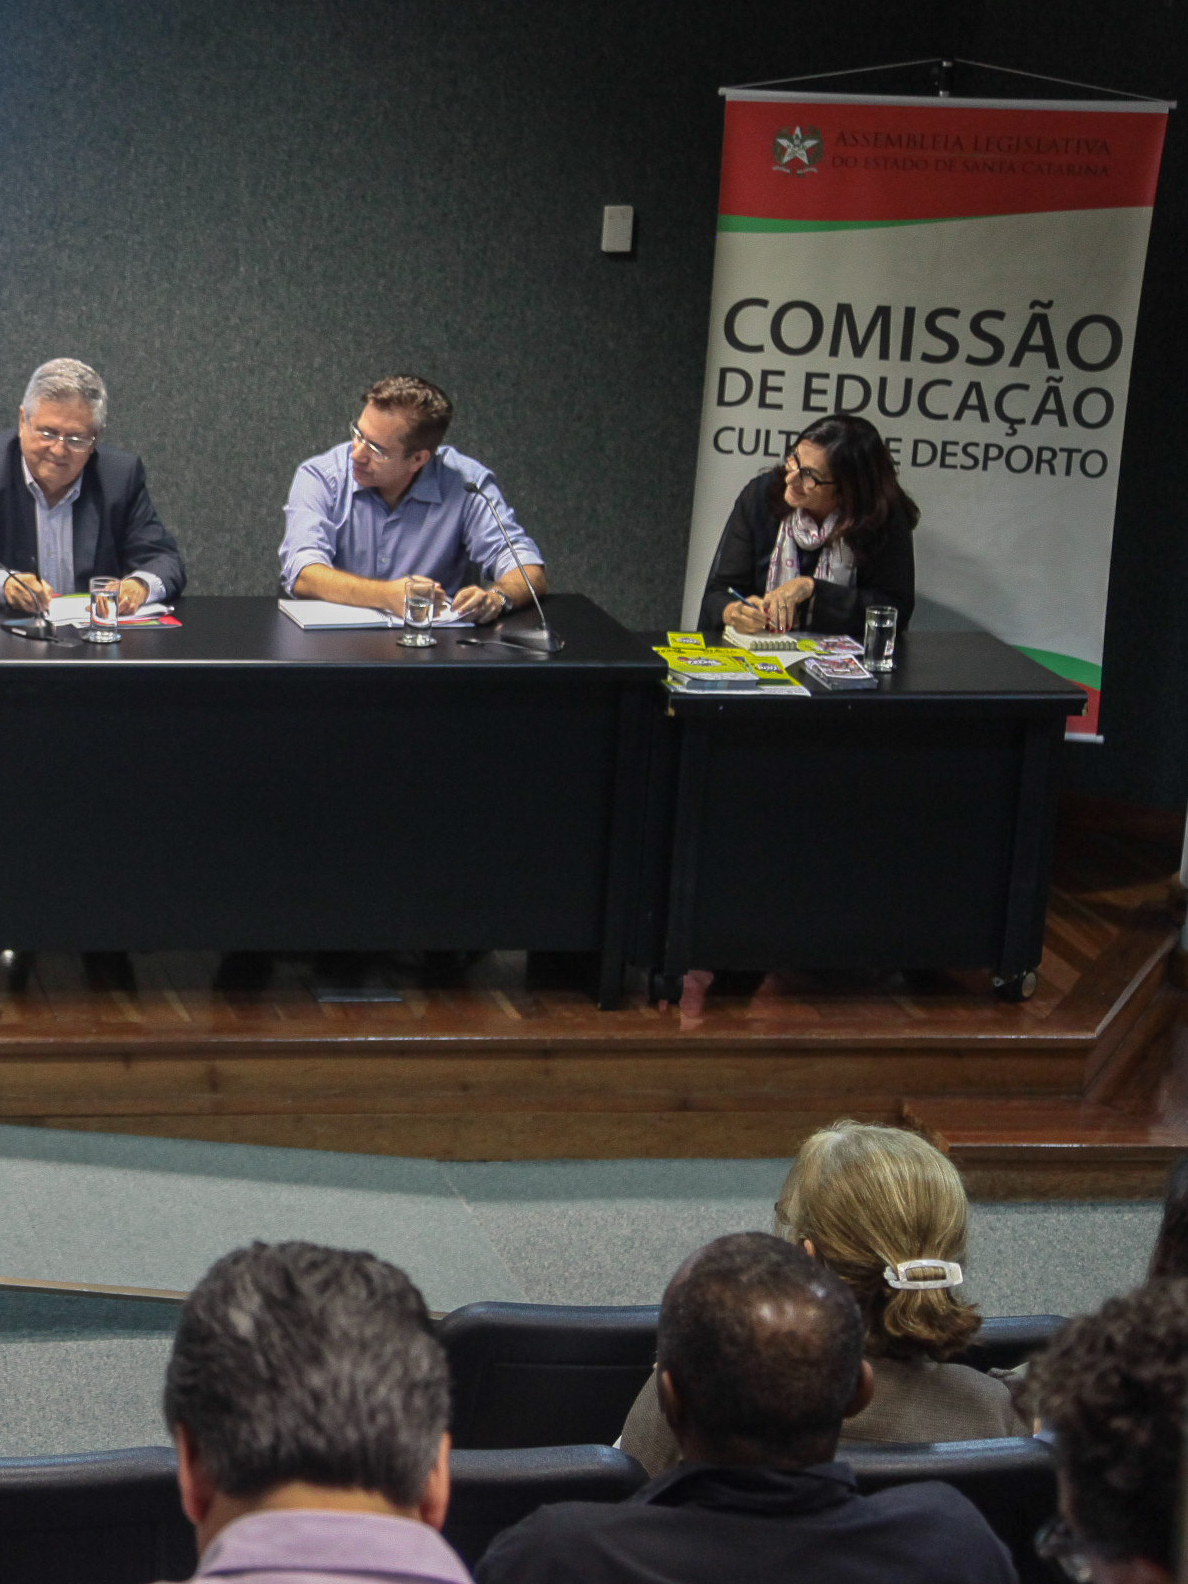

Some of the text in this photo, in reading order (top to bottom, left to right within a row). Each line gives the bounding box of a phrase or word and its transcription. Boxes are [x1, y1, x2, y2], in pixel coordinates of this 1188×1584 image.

[831, 155, 1109, 177] DO ESTADO DE SANTA CATARINA
[835, 131, 1111, 155] ASSEMBLEIA LEGISLATIVA
[723, 298, 1123, 373] COMISSÃO
[716, 367, 1115, 437] DE EDUCAÇÃO
[713, 426, 803, 458] CULT
[911, 438, 1109, 479] DESPORTO
